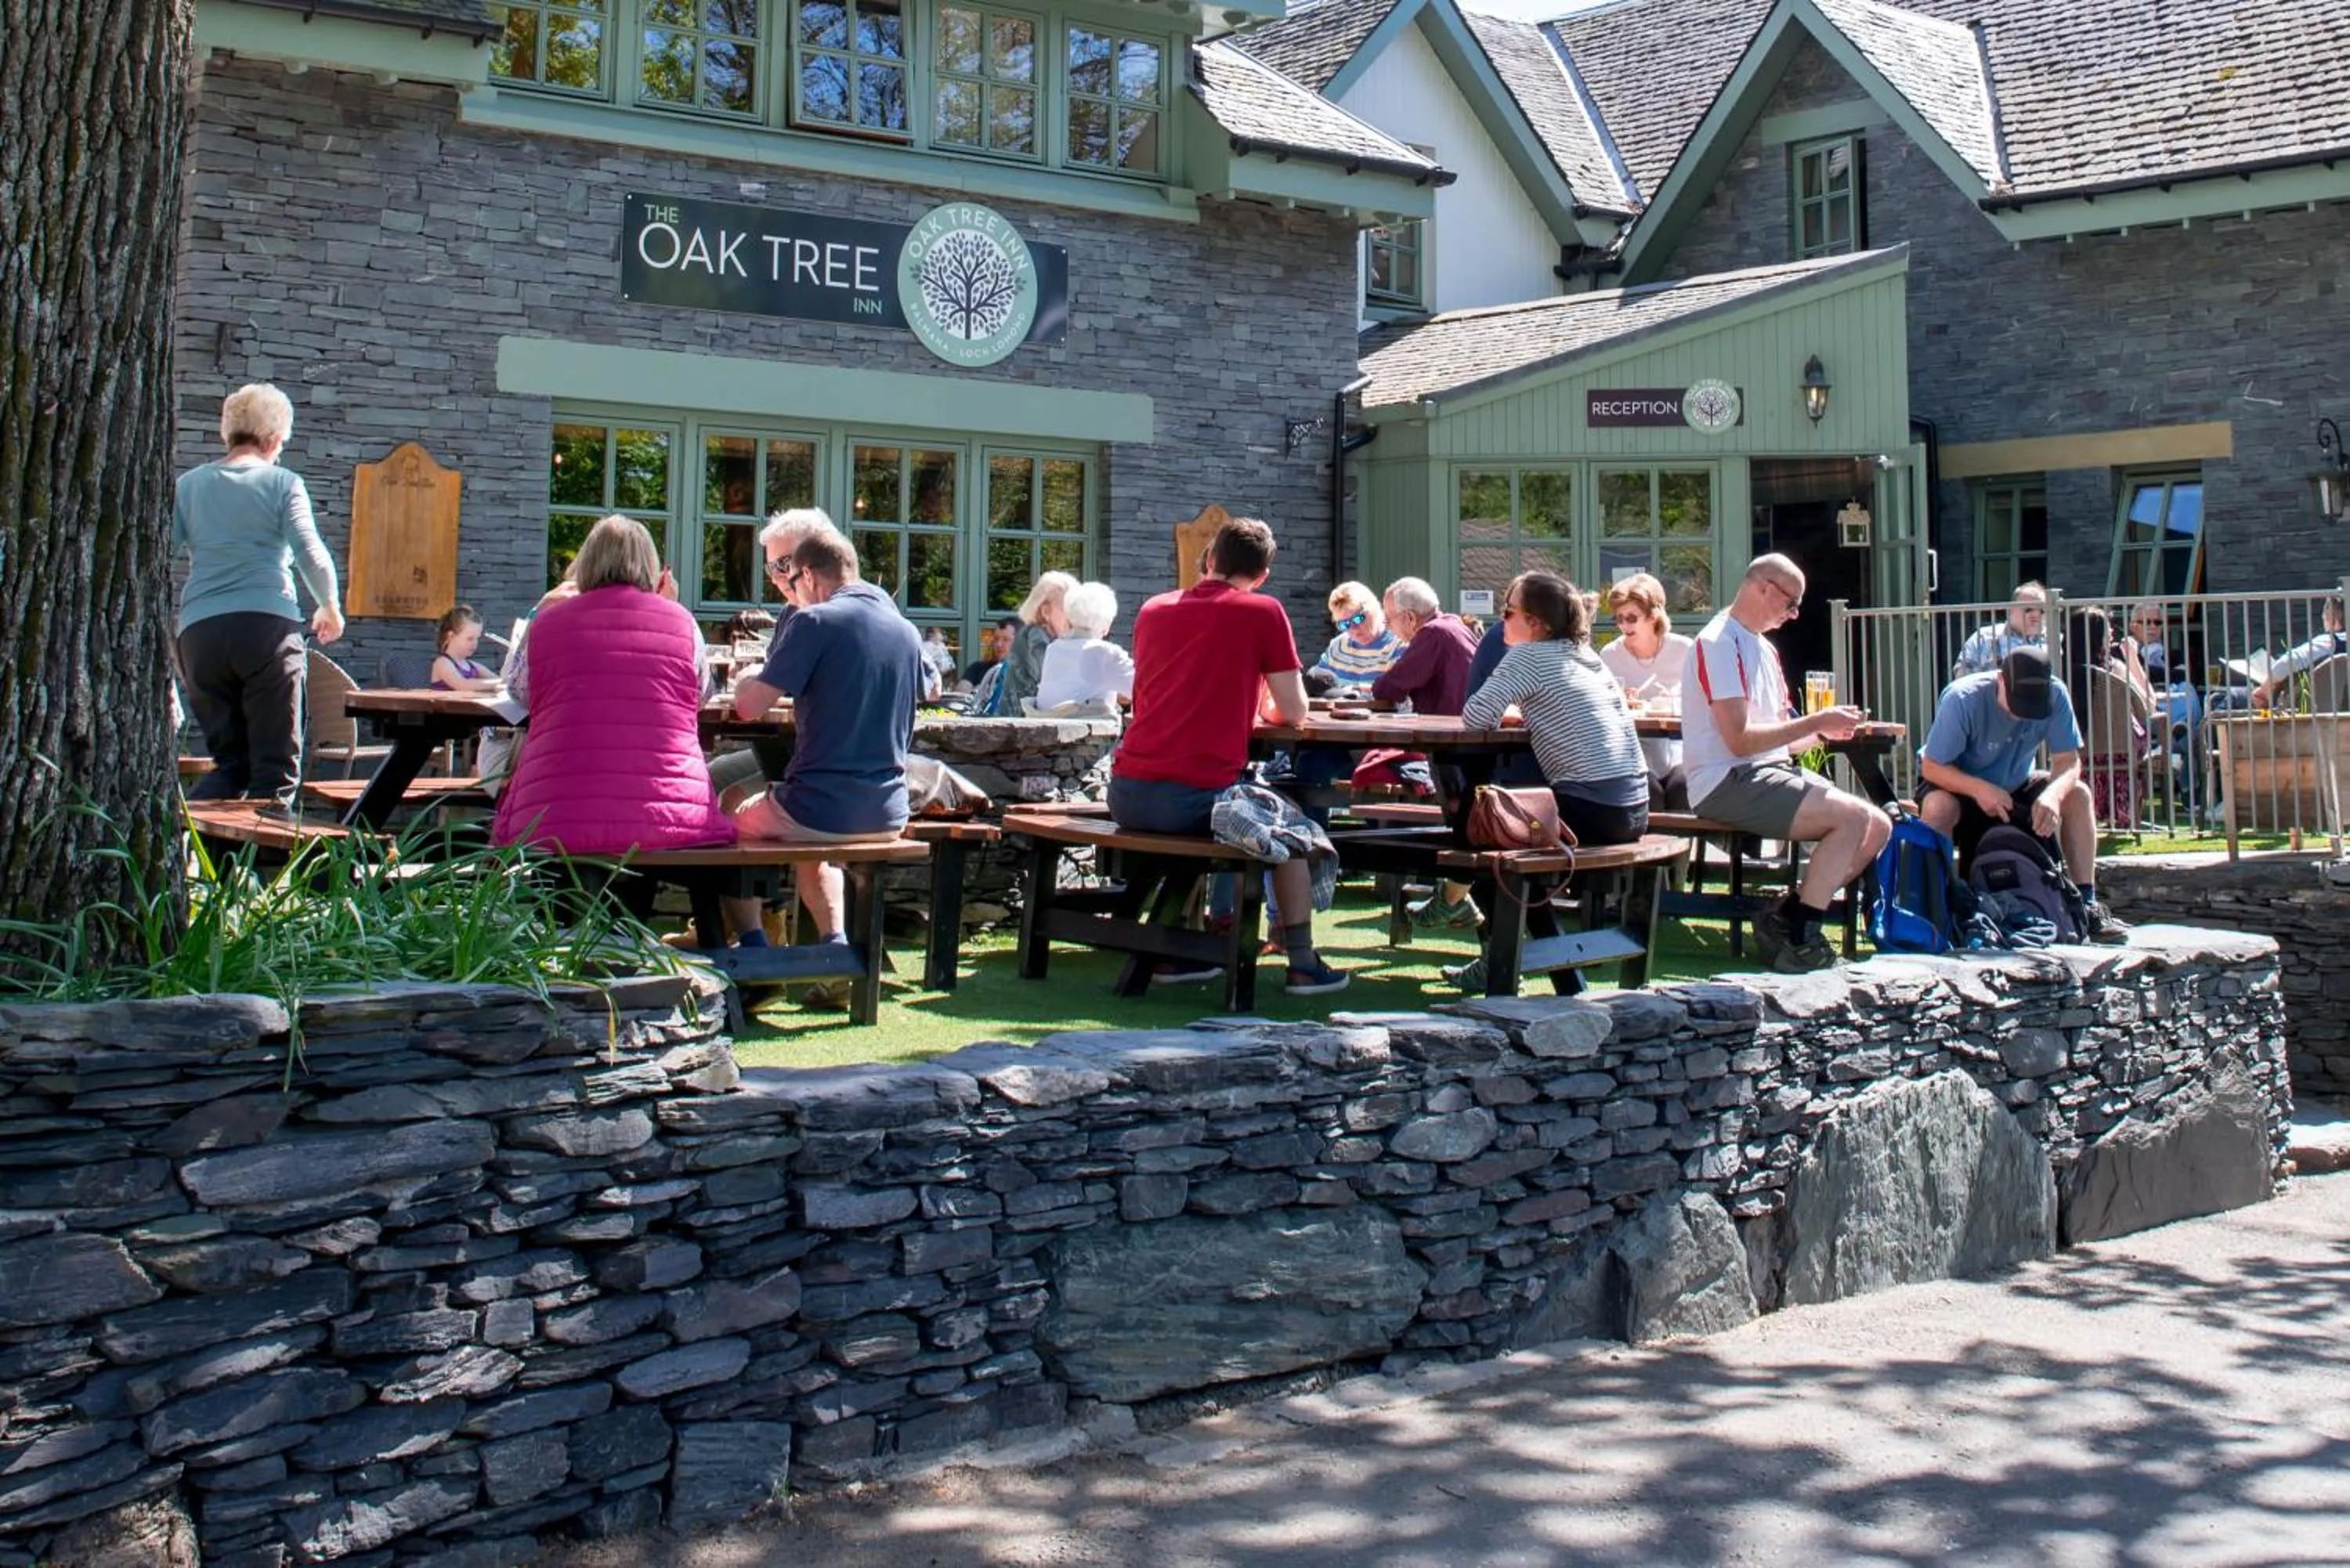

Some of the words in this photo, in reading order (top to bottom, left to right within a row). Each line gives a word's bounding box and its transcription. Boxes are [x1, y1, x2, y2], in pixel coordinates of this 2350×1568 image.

[644, 203, 679, 223] THE
[908, 215, 944, 258] OAK
[945, 207, 999, 233] TREE
[1000, 230, 1029, 271] INN
[638, 222, 747, 278] OAK
[762, 234, 880, 292] TREE
[852, 297, 883, 314] INN
[960, 348, 989, 359] LOCH
[991, 312, 1026, 352] LOMOND
[1592, 400, 1678, 416] RECEPTION
